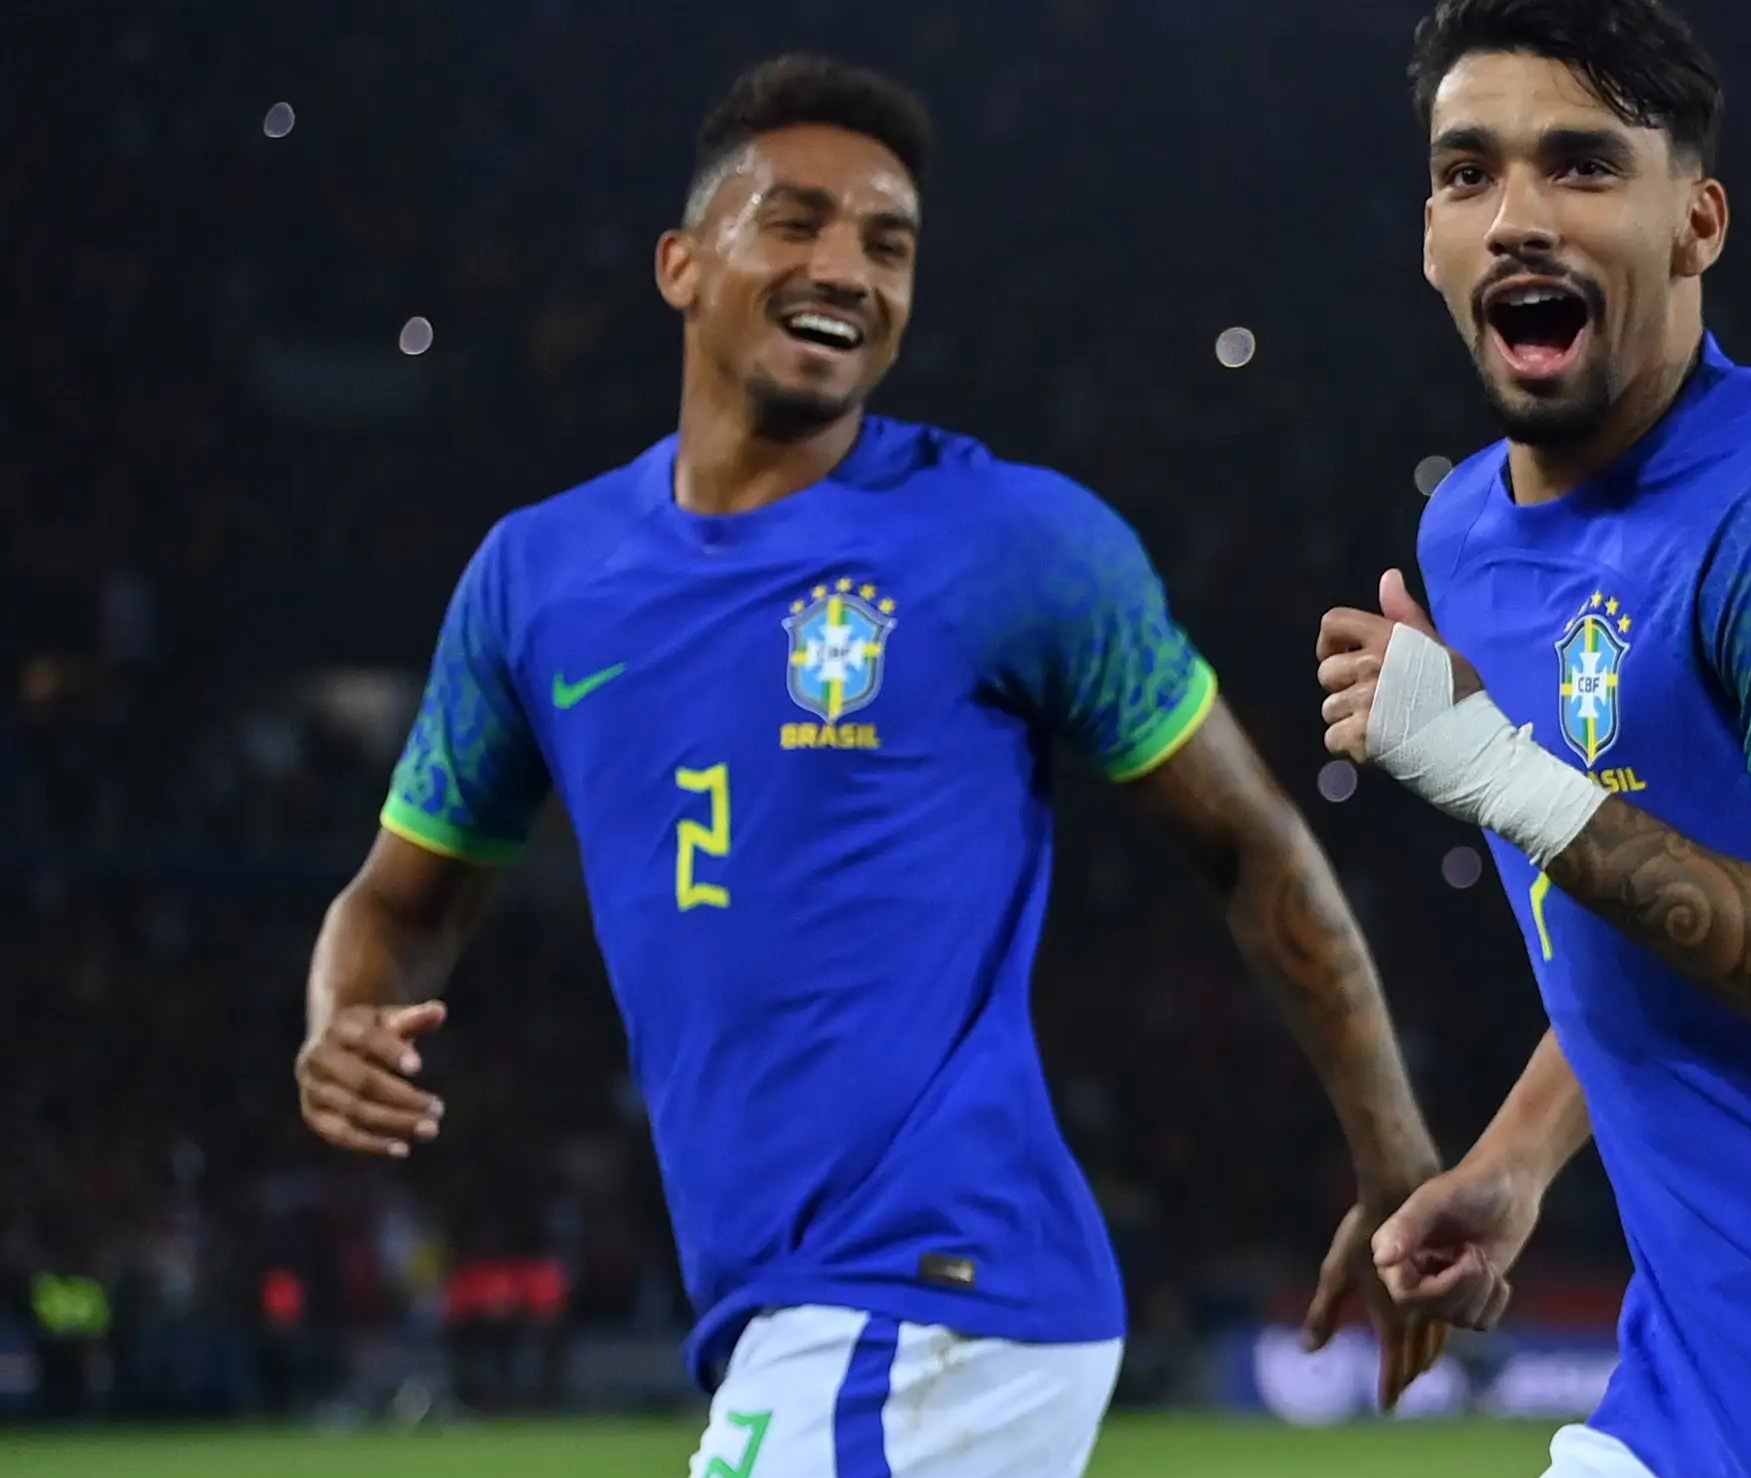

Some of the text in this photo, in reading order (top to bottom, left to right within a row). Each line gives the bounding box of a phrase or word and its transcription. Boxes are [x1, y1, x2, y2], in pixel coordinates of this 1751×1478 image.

[1577, 676, 1601, 694] CBF
[779, 723, 881, 749] BRASIL
[675, 761, 731, 914] 2
